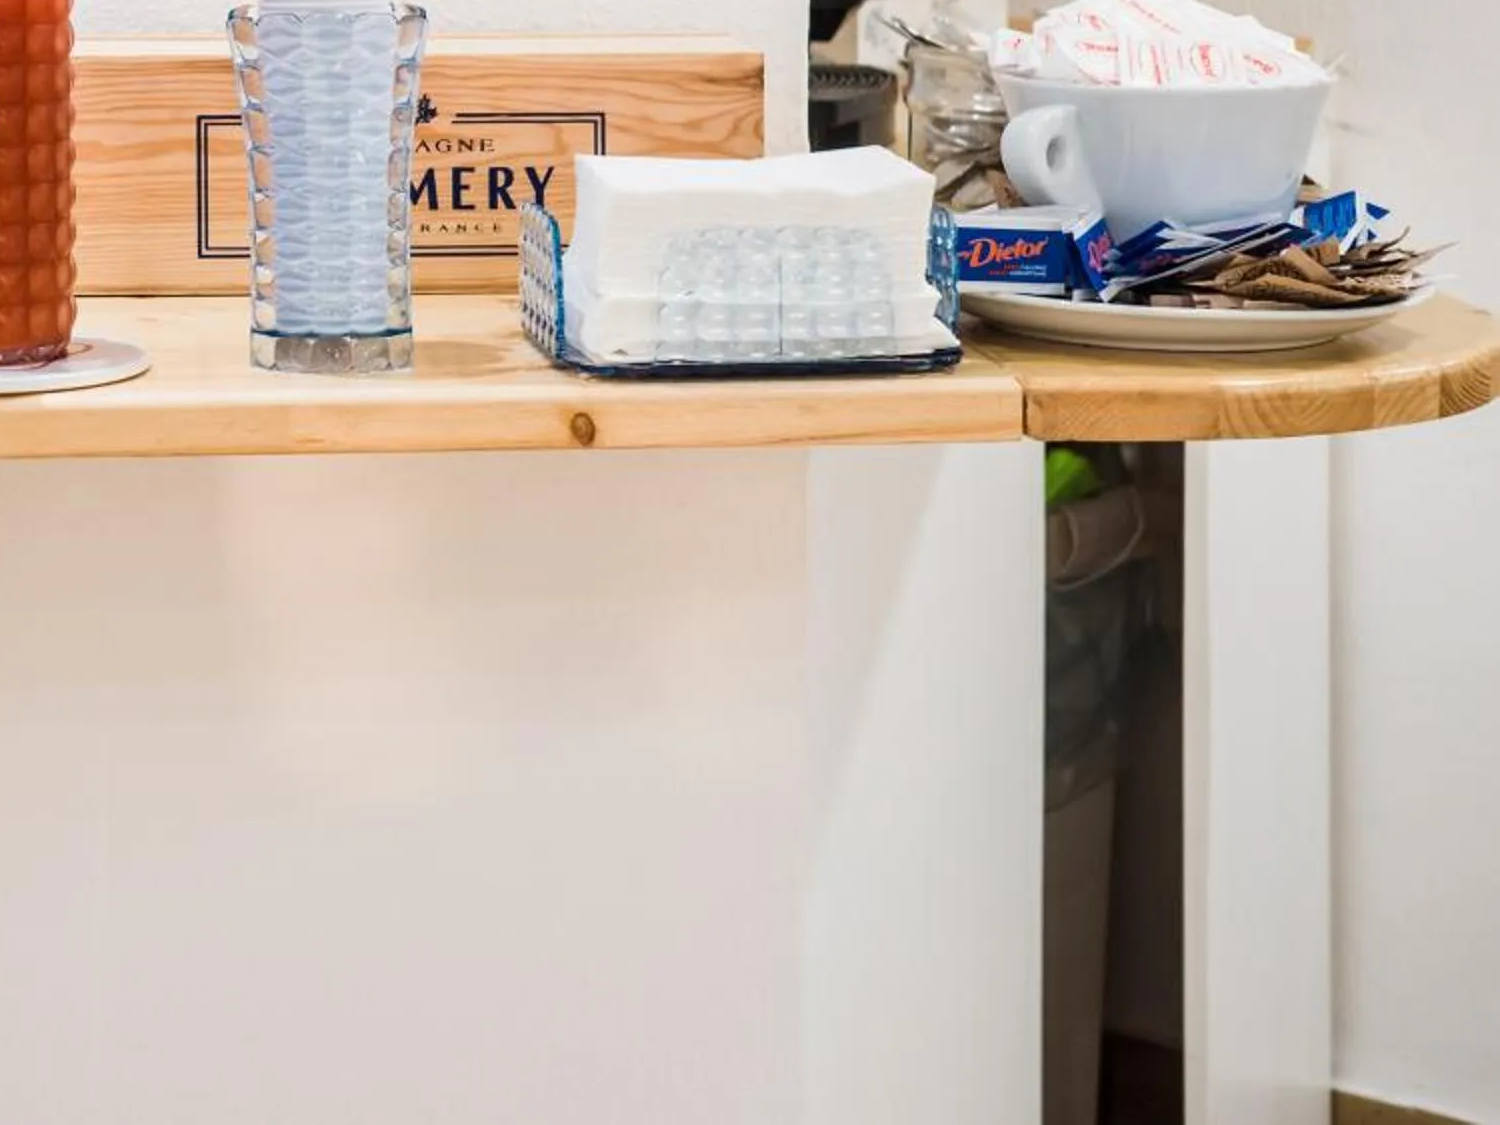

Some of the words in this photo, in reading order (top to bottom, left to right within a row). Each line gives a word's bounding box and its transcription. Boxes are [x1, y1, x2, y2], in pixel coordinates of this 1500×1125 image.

[409, 165, 556, 212] MERY
[419, 222, 503, 234] RANCE
[966, 235, 1049, 268] Dietor
